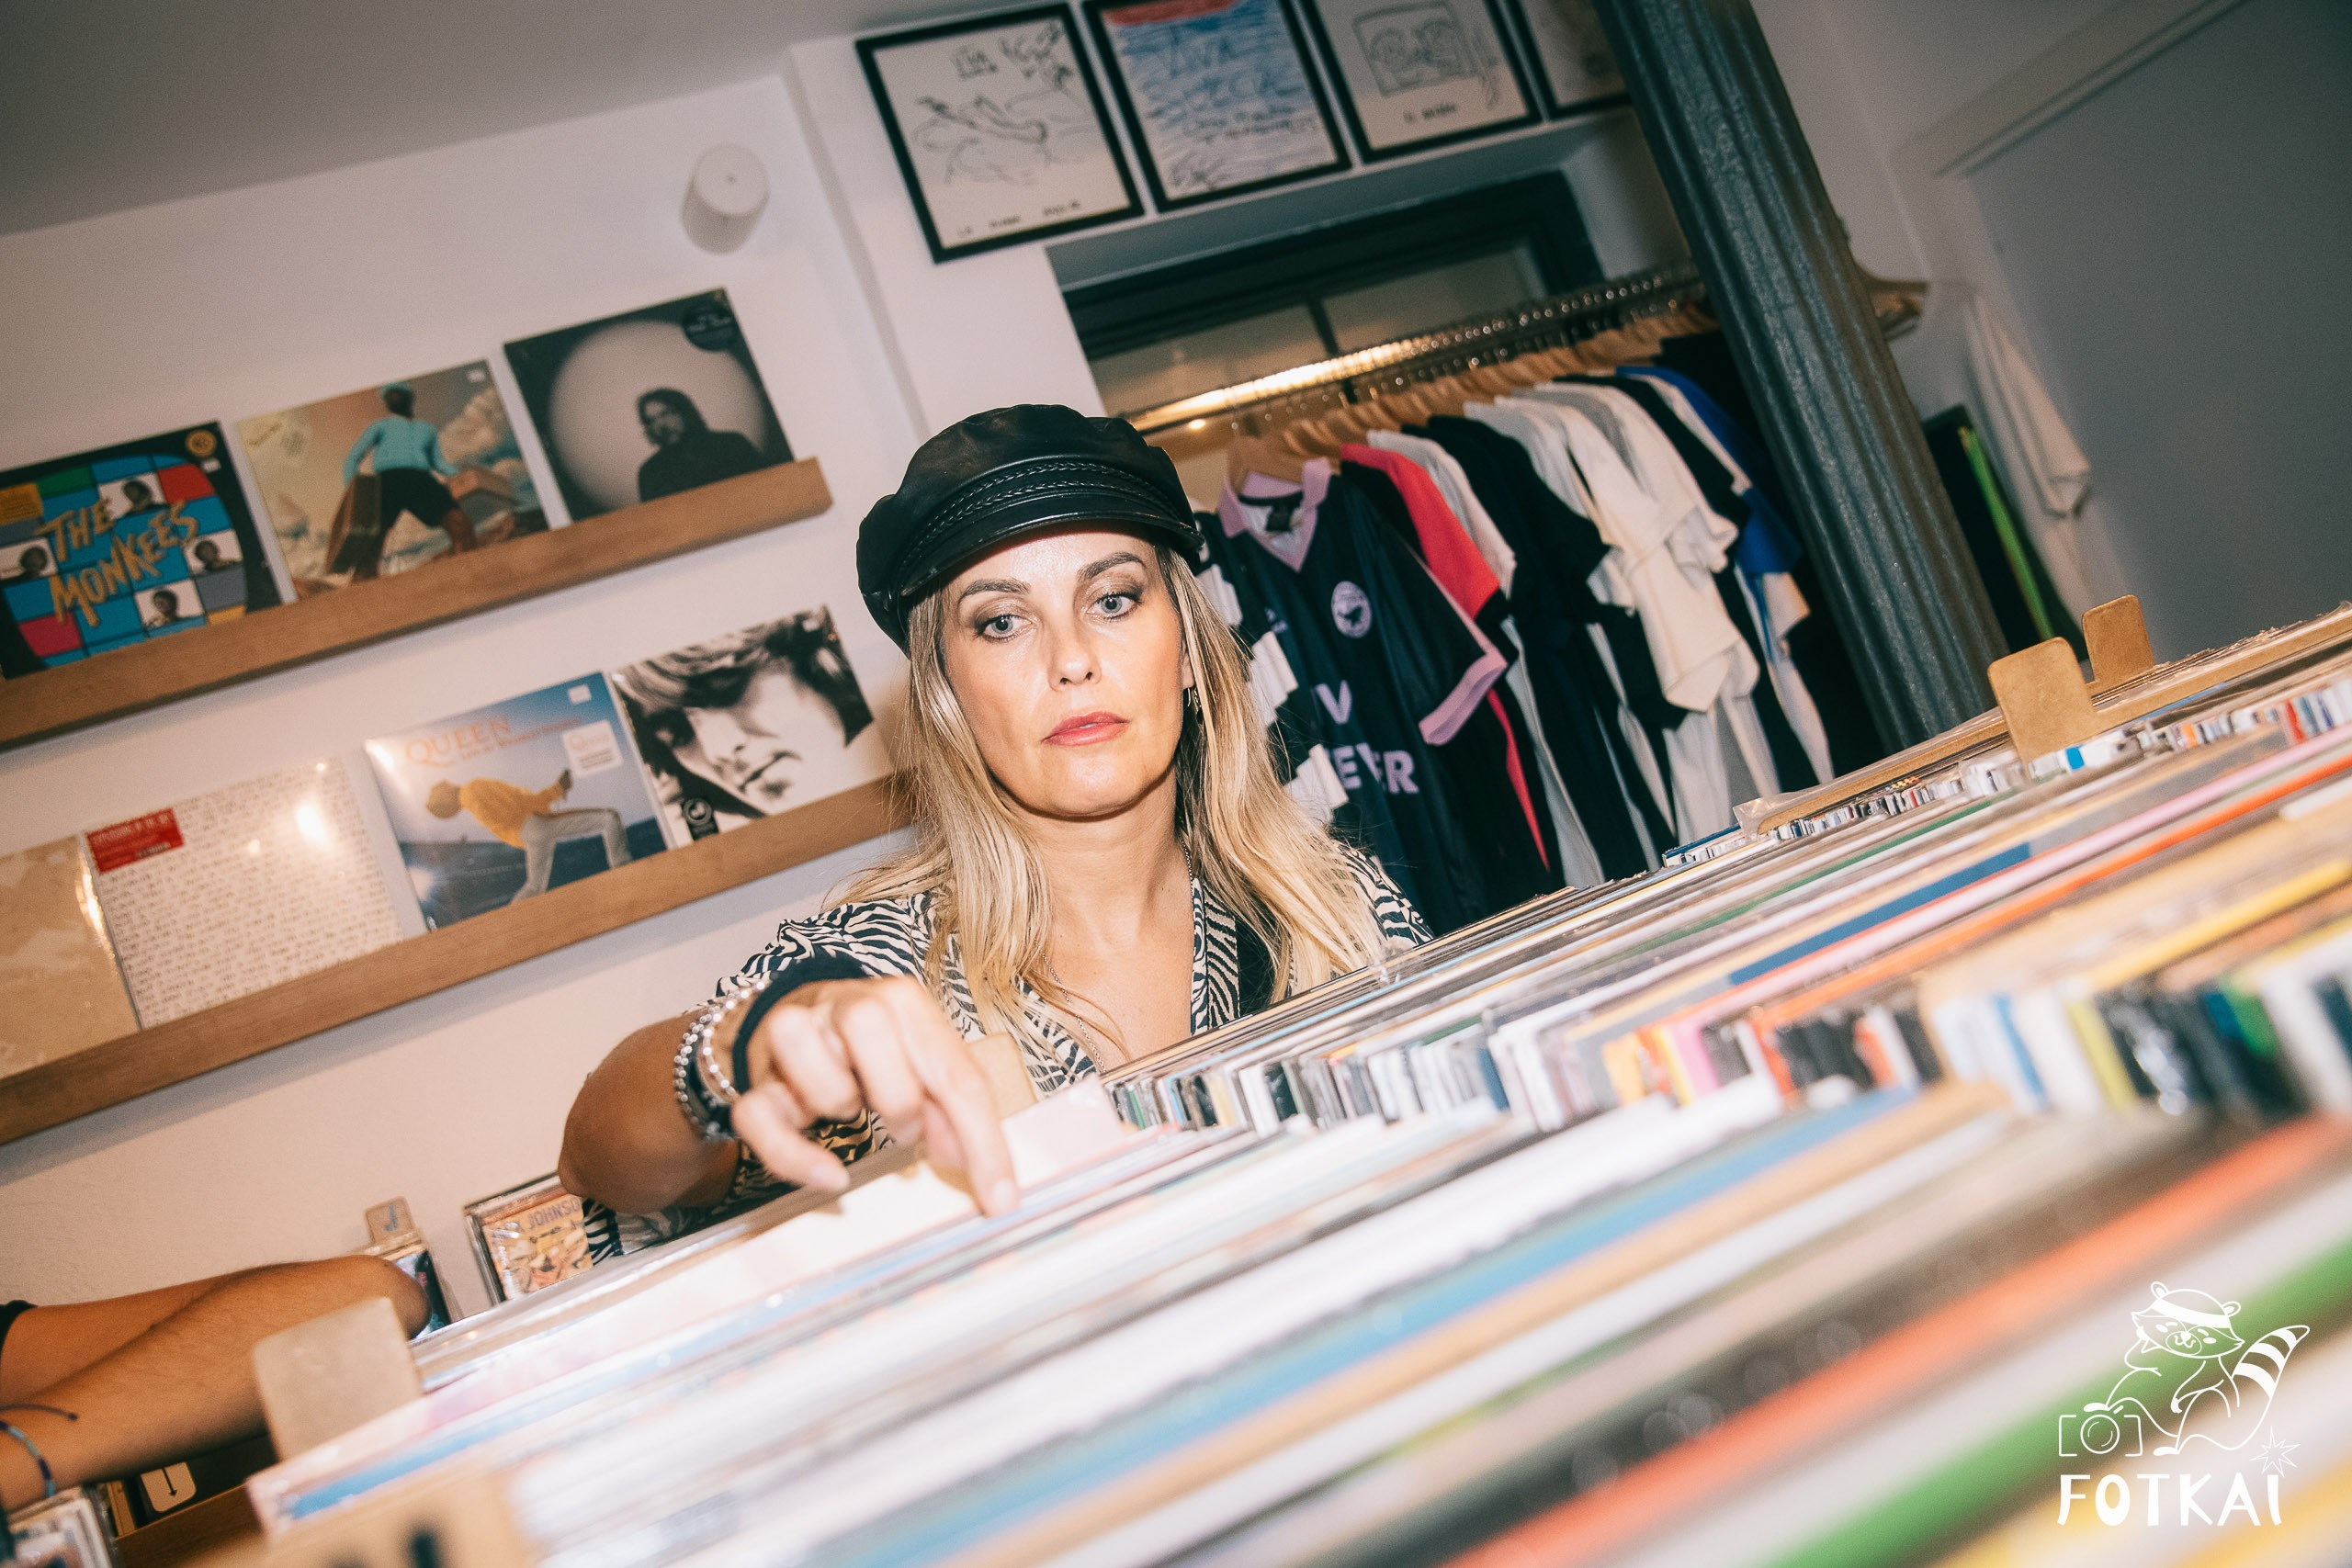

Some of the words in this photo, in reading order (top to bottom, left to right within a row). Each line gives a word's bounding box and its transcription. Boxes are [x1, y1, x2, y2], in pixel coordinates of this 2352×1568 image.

[35, 497, 115, 562] THE
[48, 500, 198, 628] MONKEES
[404, 715, 511, 768] QUEEN
[528, 1196, 582, 1231] JOHNSO
